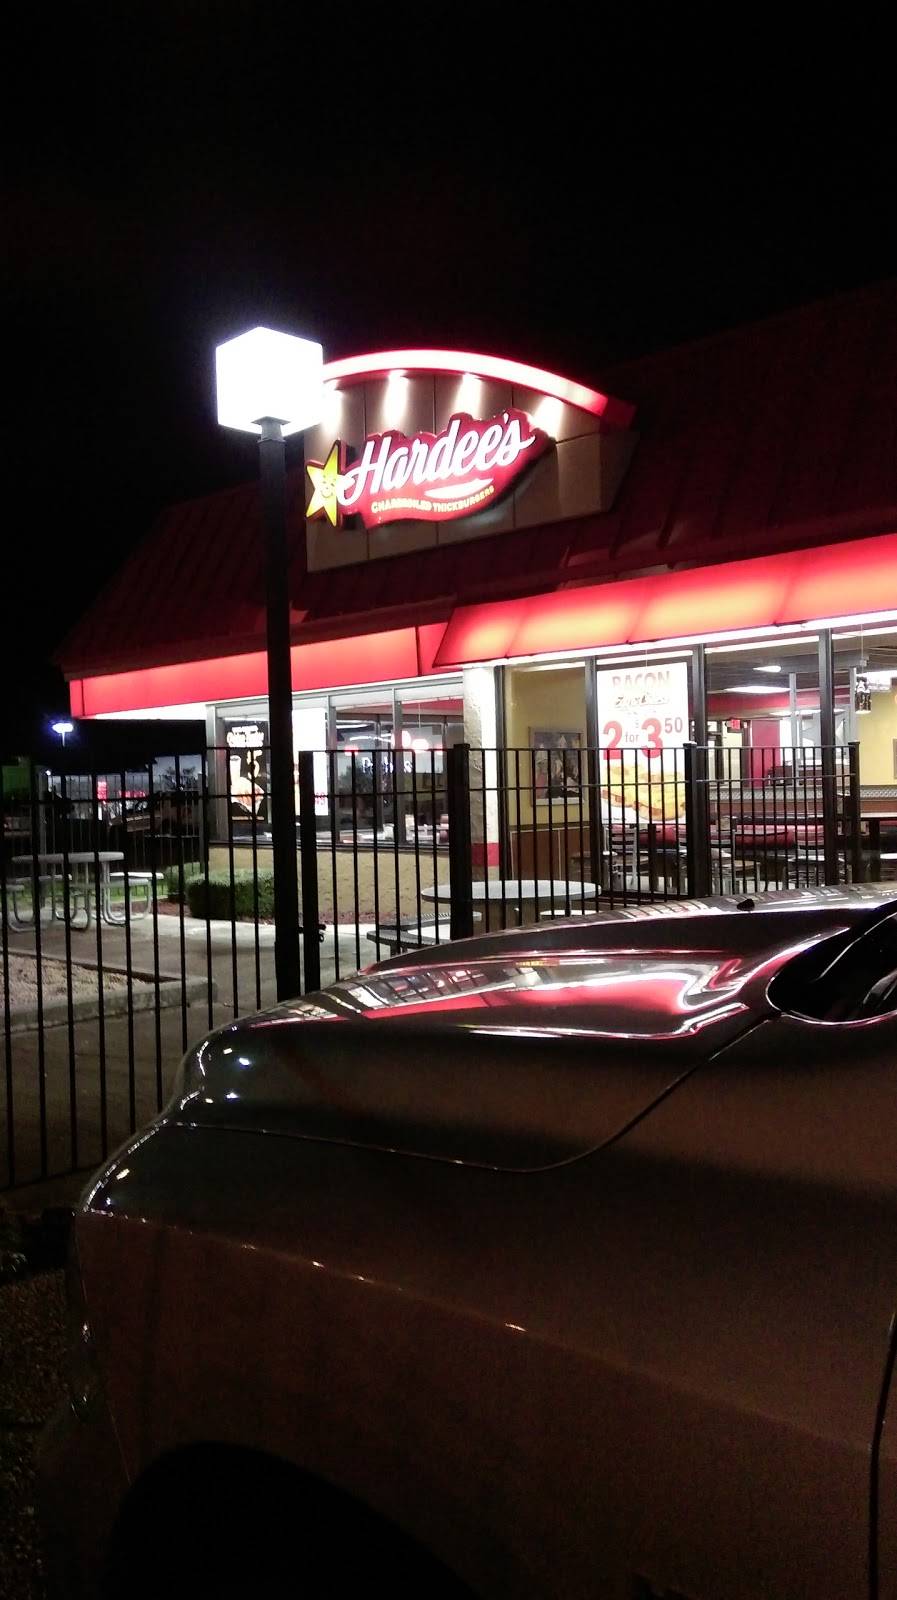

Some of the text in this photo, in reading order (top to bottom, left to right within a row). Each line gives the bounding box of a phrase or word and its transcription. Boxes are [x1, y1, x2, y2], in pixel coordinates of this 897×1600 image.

[336, 413, 535, 506] Hardee's
[603, 721, 623, 760] 2
[625, 731, 639, 743] for
